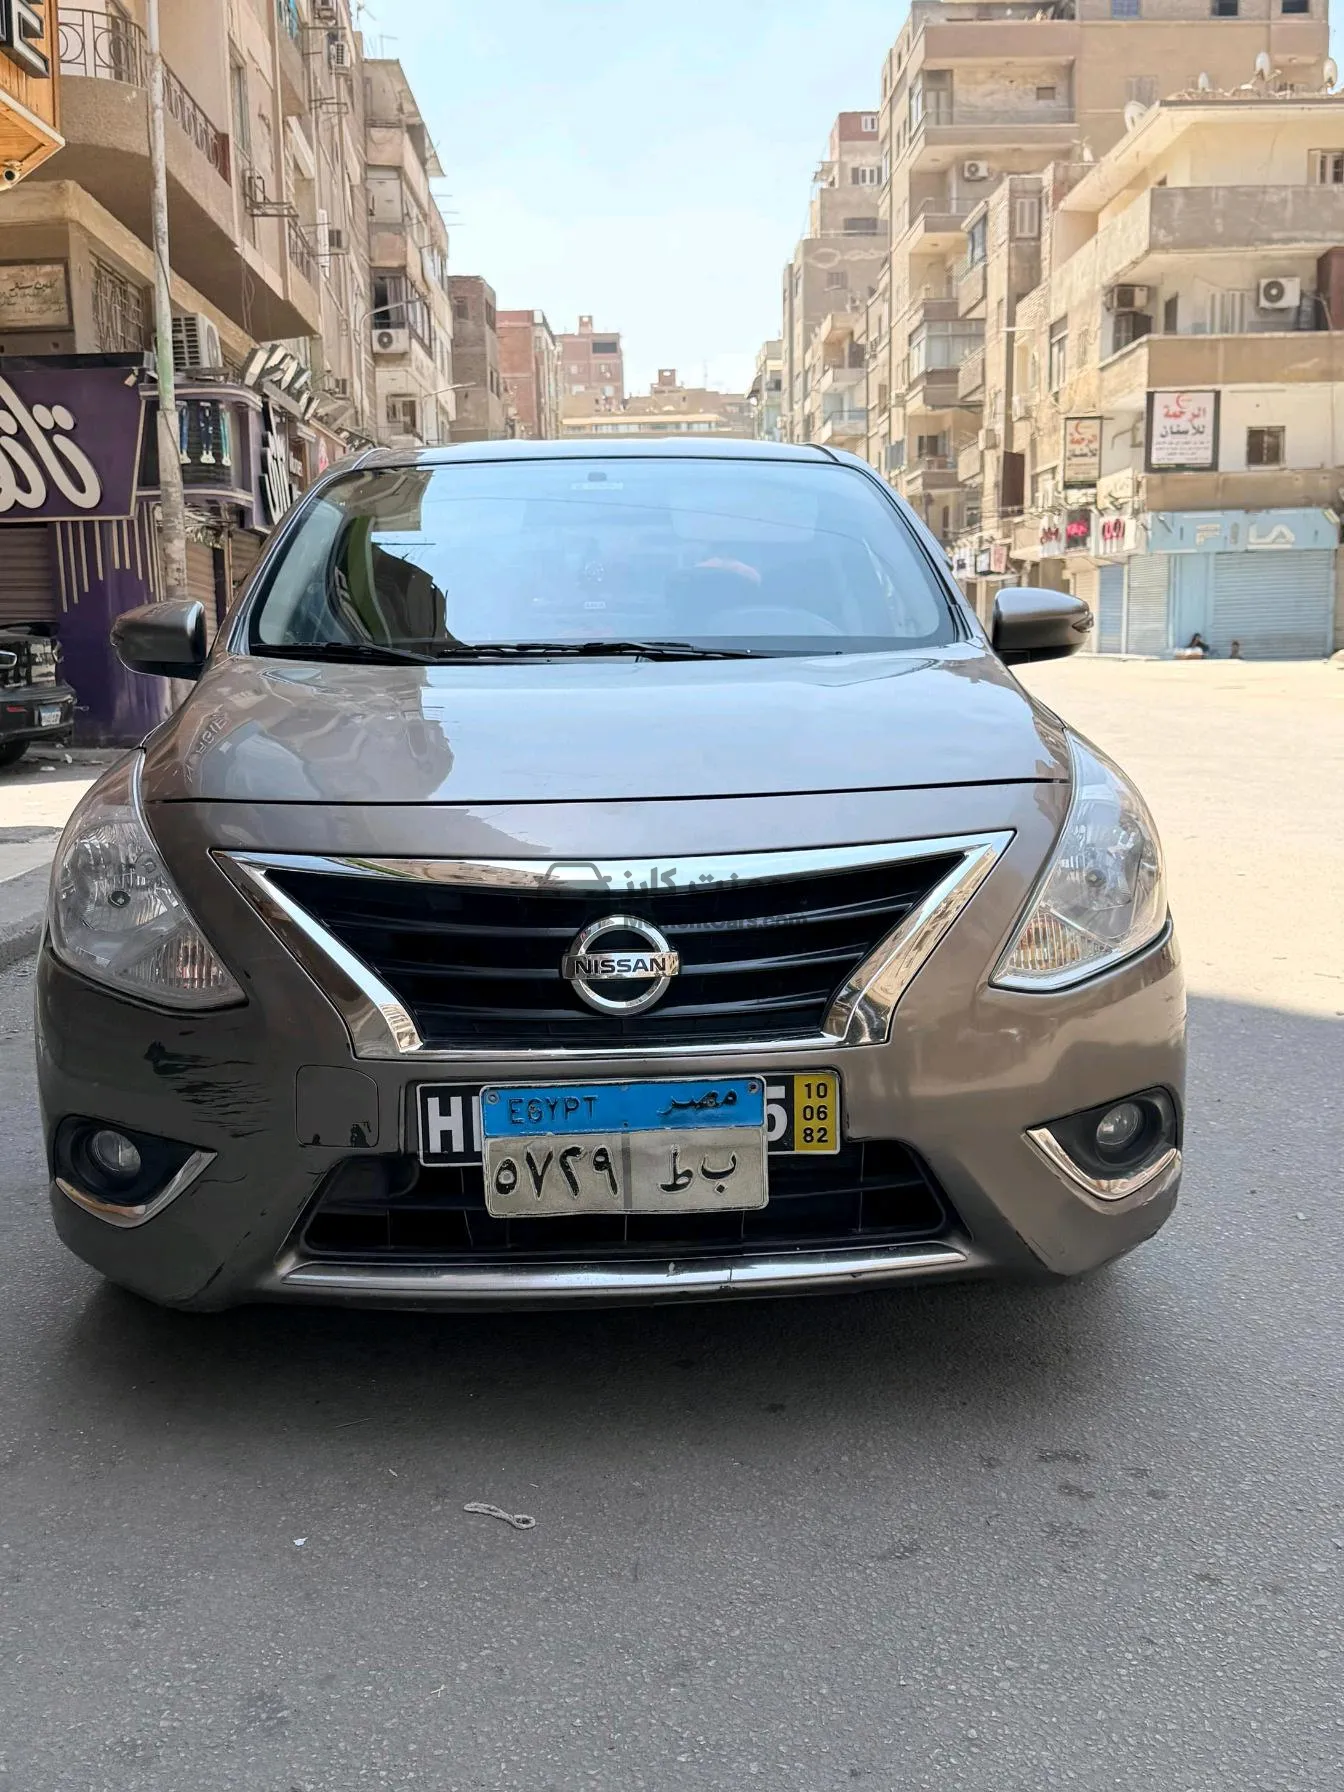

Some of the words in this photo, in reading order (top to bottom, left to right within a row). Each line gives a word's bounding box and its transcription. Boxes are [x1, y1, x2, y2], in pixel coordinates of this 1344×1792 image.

[1163, 405, 1206, 424] الرحمة
[575, 957, 666, 974] NISSAN
[804, 1083, 828, 1098] 10
[508, 1095, 598, 1125] EGYPT
[657, 1090, 738, 1116] مصر
[802, 1104, 829, 1121] 06
[803, 1127, 829, 1143] 82
